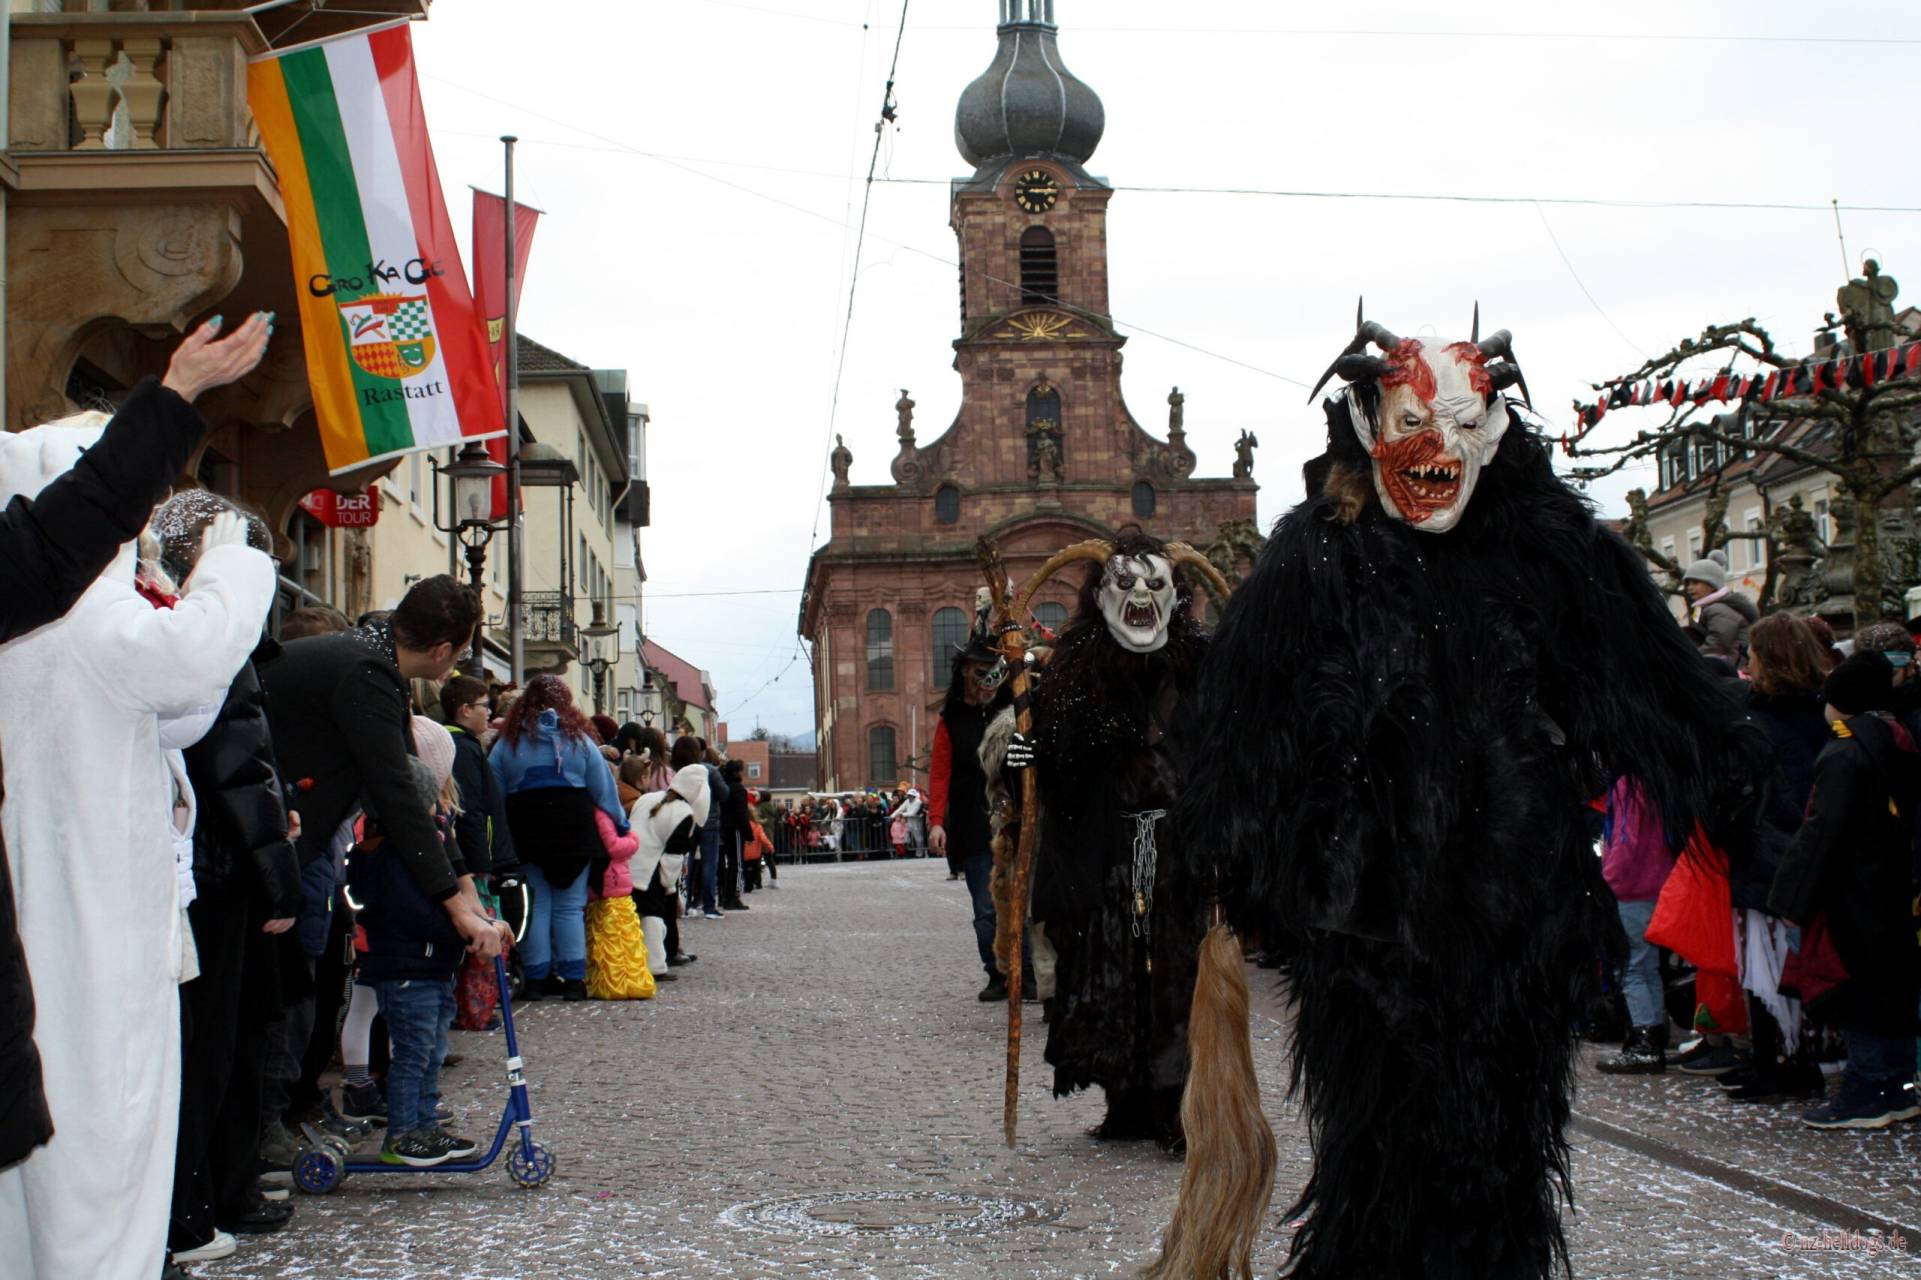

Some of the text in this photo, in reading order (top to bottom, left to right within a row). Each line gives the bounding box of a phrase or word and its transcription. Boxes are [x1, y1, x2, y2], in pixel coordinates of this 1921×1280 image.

[363, 380, 444, 406] Rastatt
[336, 494, 371, 510] DER
[336, 511, 372, 524] TOUR
